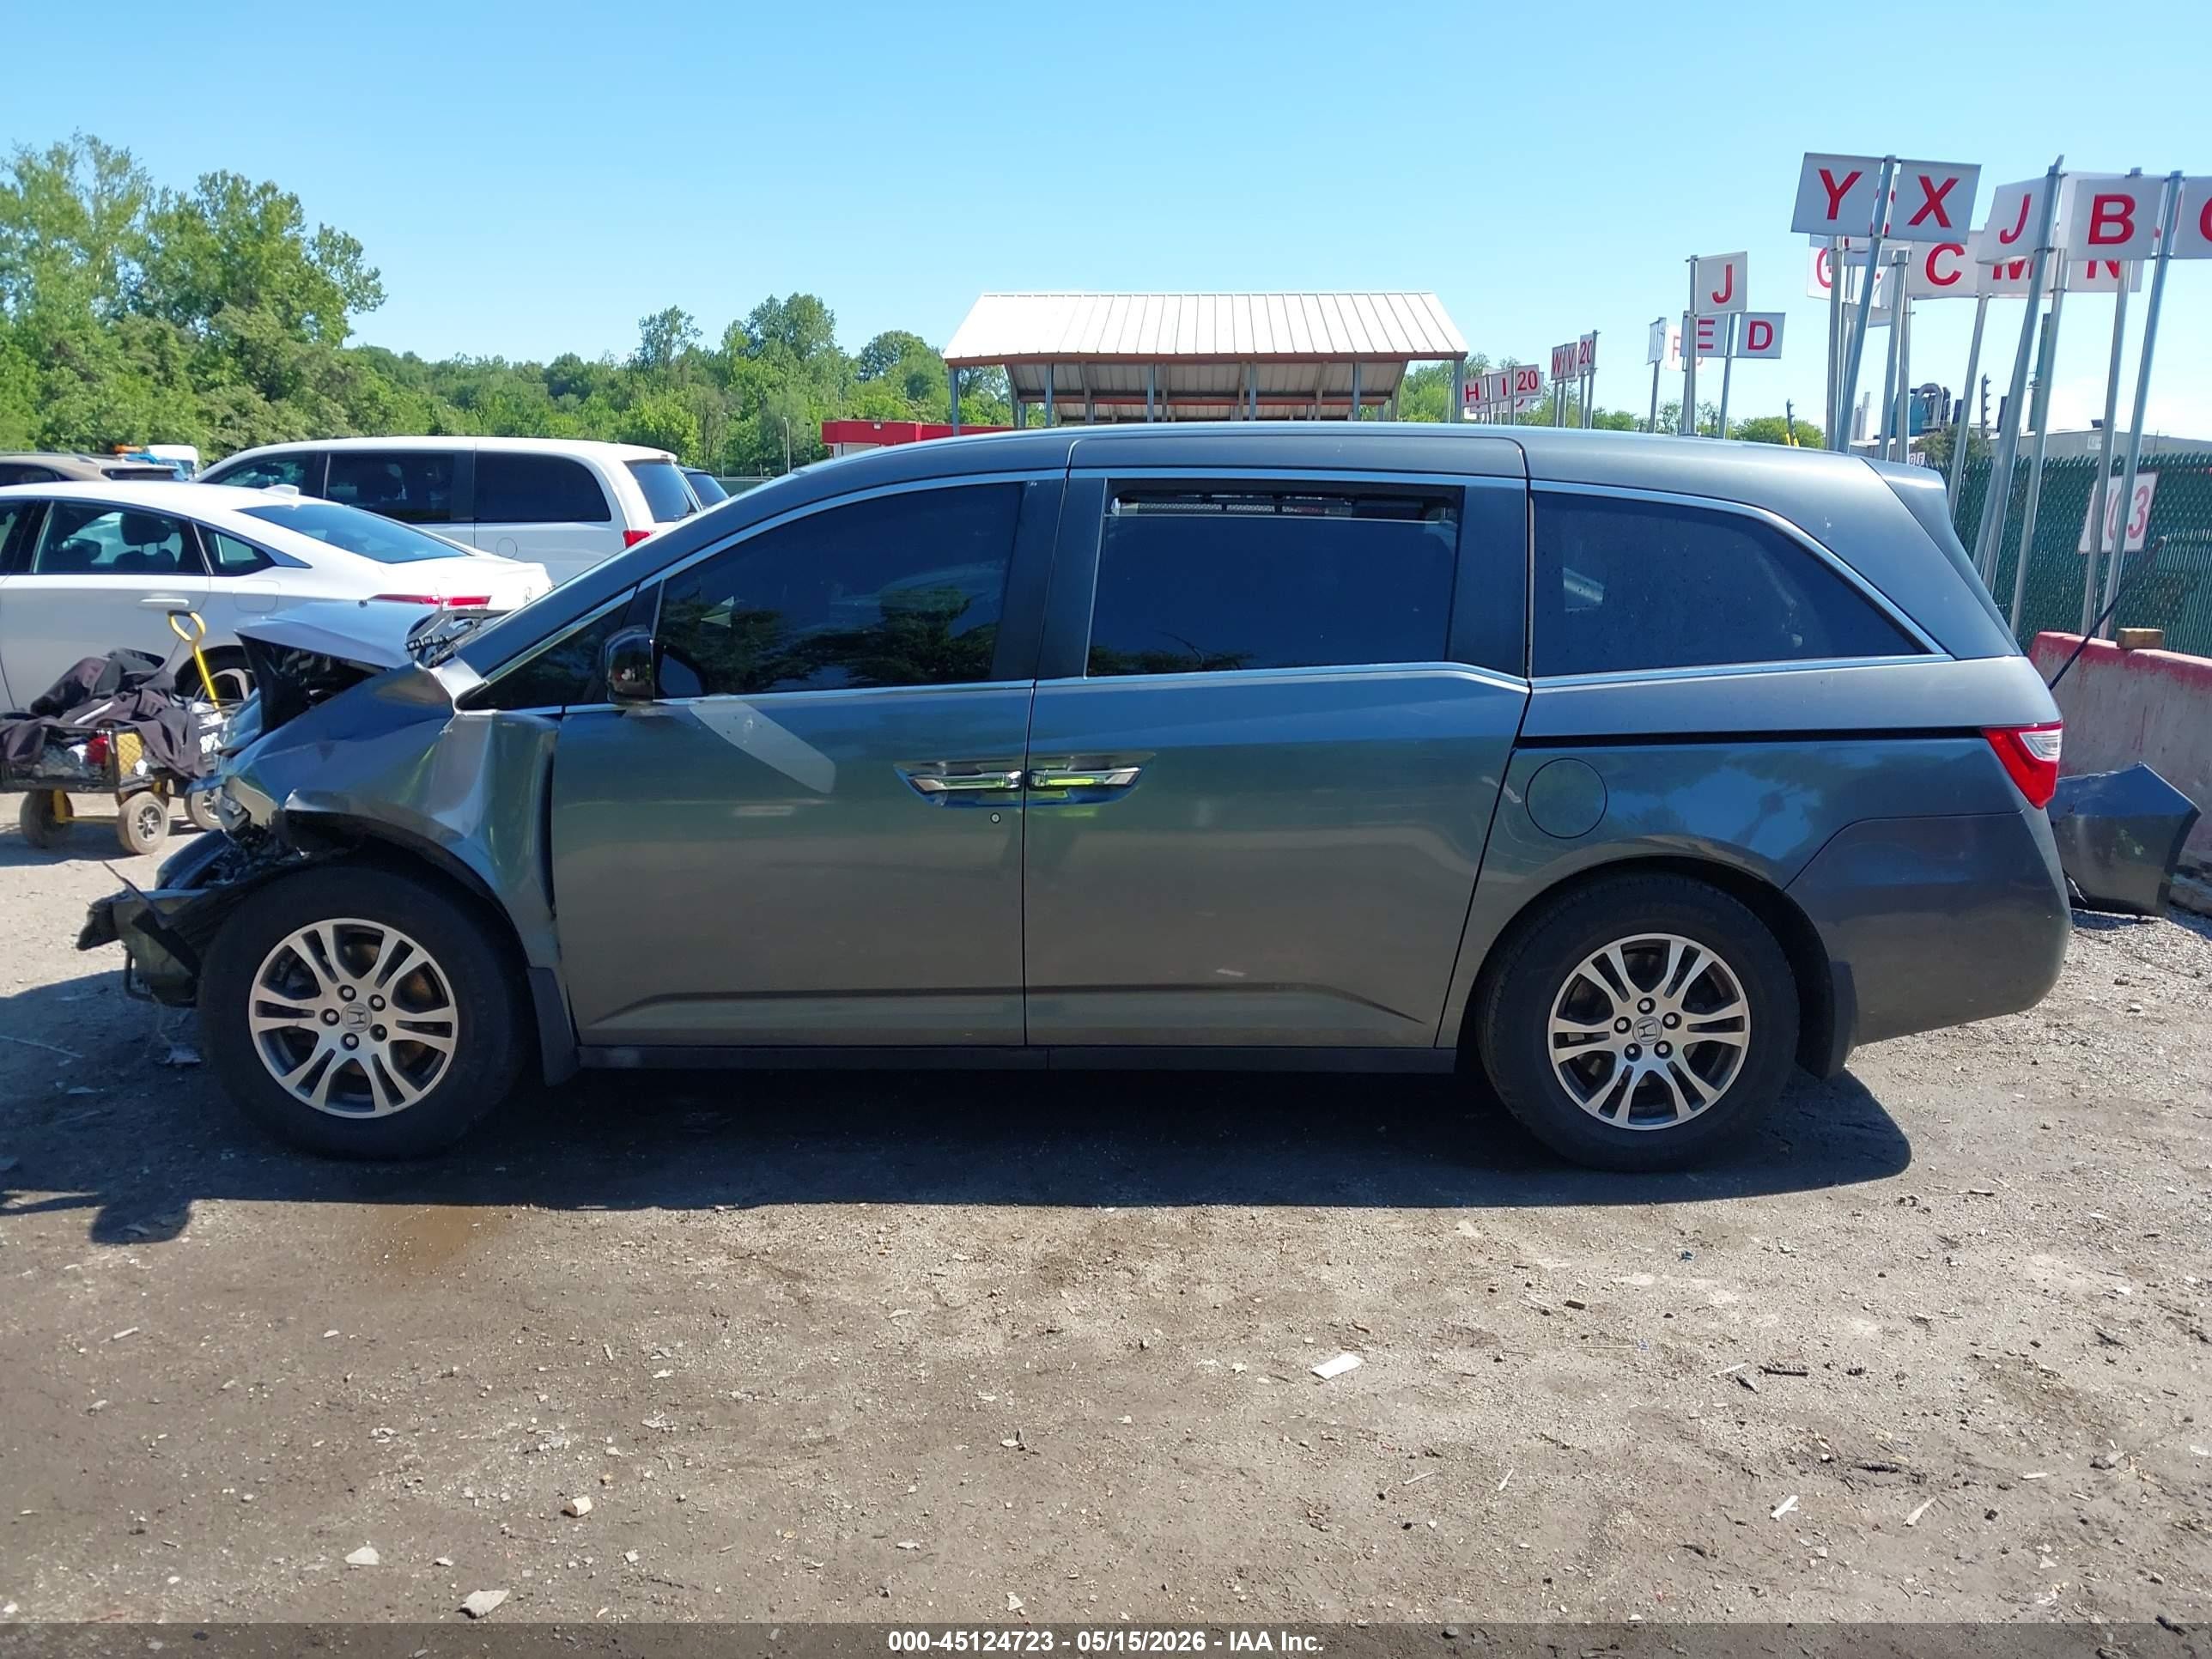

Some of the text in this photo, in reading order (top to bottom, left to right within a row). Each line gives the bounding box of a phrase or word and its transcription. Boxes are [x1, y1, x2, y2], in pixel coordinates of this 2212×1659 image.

[1818, 169, 1863, 220] Y
[1907, 175, 1959, 228] X
[2000, 193, 2032, 245] J
[2087, 194, 2136, 245] B
[1925, 243, 1965, 286] C
[1712, 264, 1733, 304] J
[1697, 319, 1716, 349] E
[1747, 320, 1773, 350] D
[1553, 351, 1562, 374] W
[1567, 348, 1576, 372] V
[1465, 382, 1480, 403] H
[1502, 377, 1507, 396] I
[1517, 370, 1538, 391] 20
